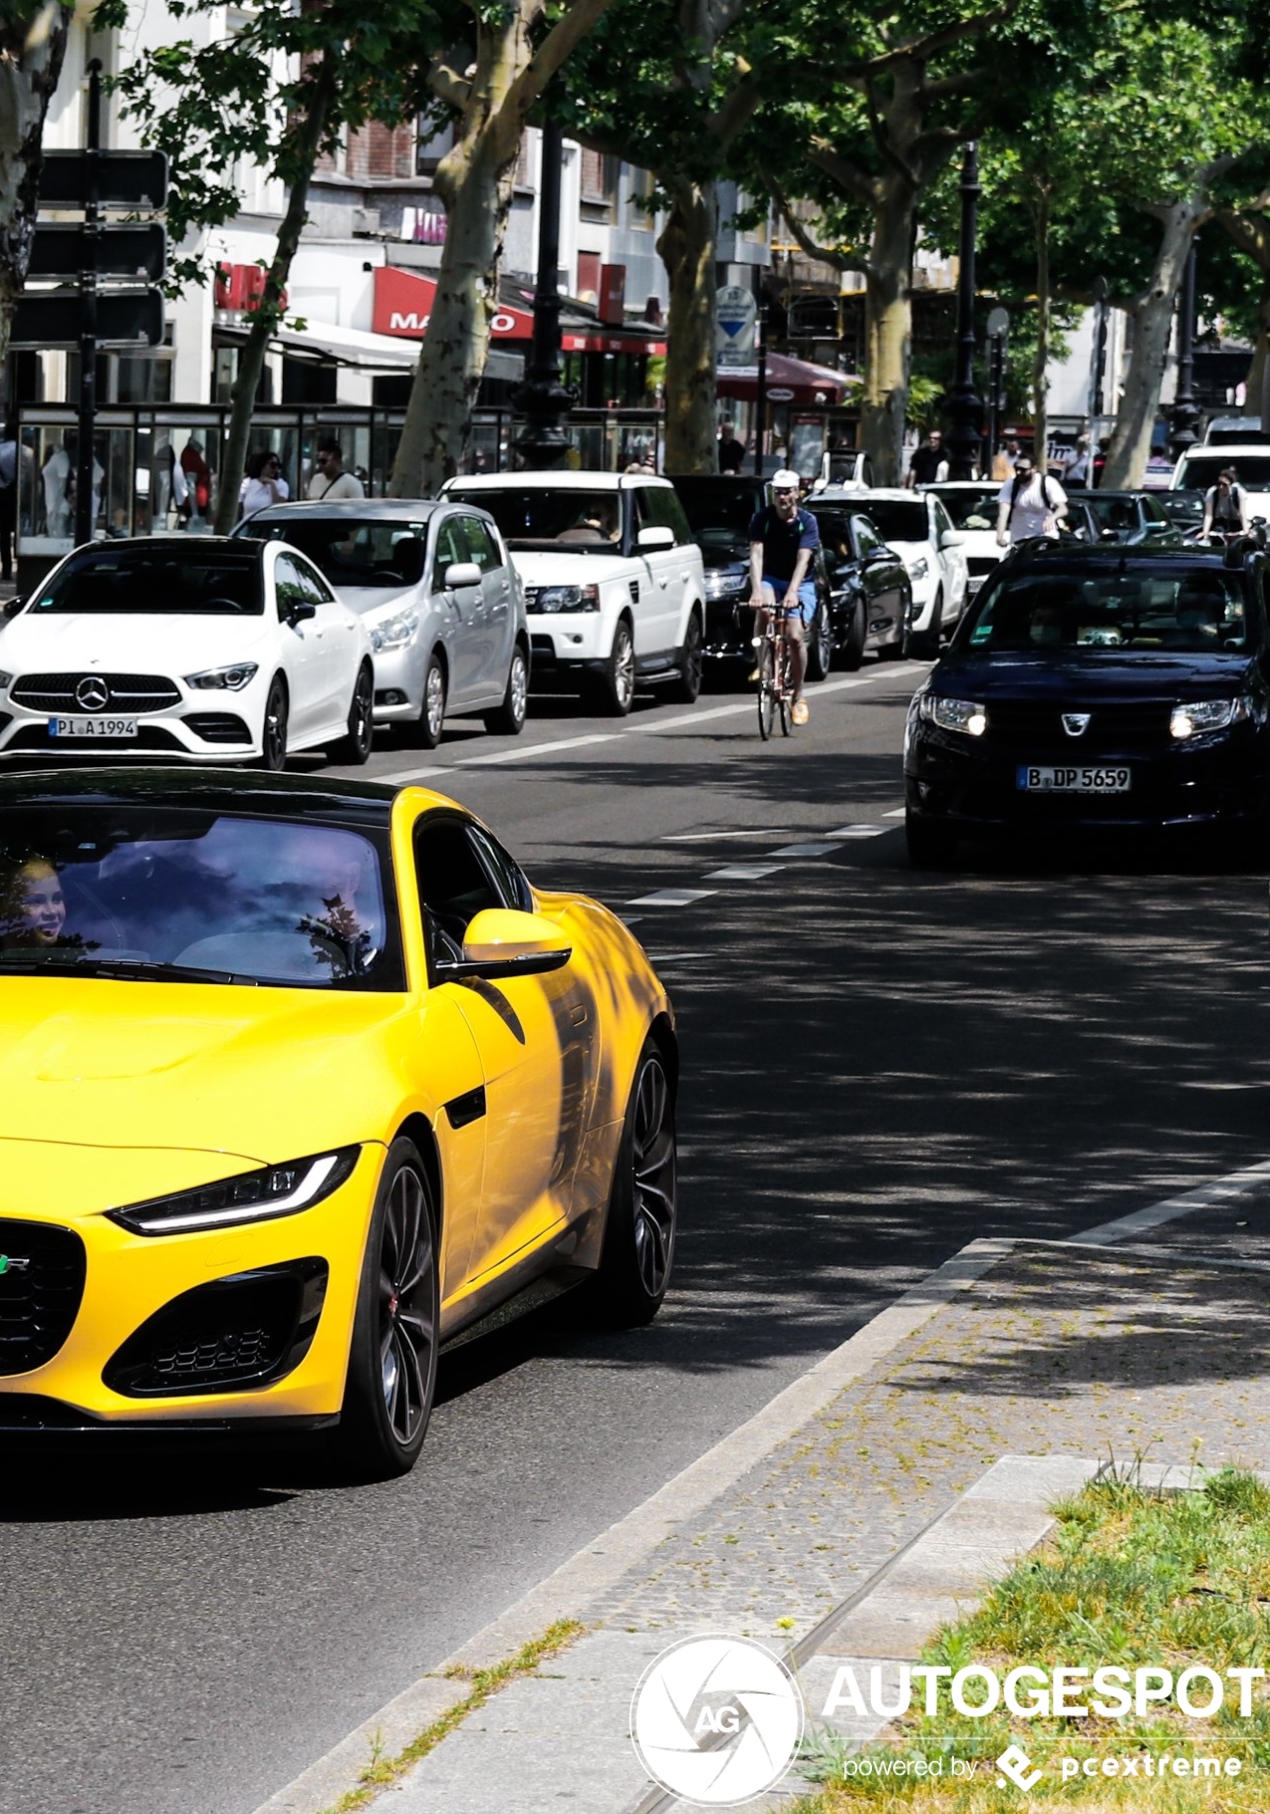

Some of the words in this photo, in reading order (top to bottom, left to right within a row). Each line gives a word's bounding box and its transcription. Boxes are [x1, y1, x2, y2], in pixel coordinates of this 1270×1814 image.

[58, 720, 76, 735] PI
[98, 720, 135, 735] 1994
[1029, 769, 1041, 787] B
[1053, 769, 1077, 787] DP
[1081, 769, 1129, 788] 5659
